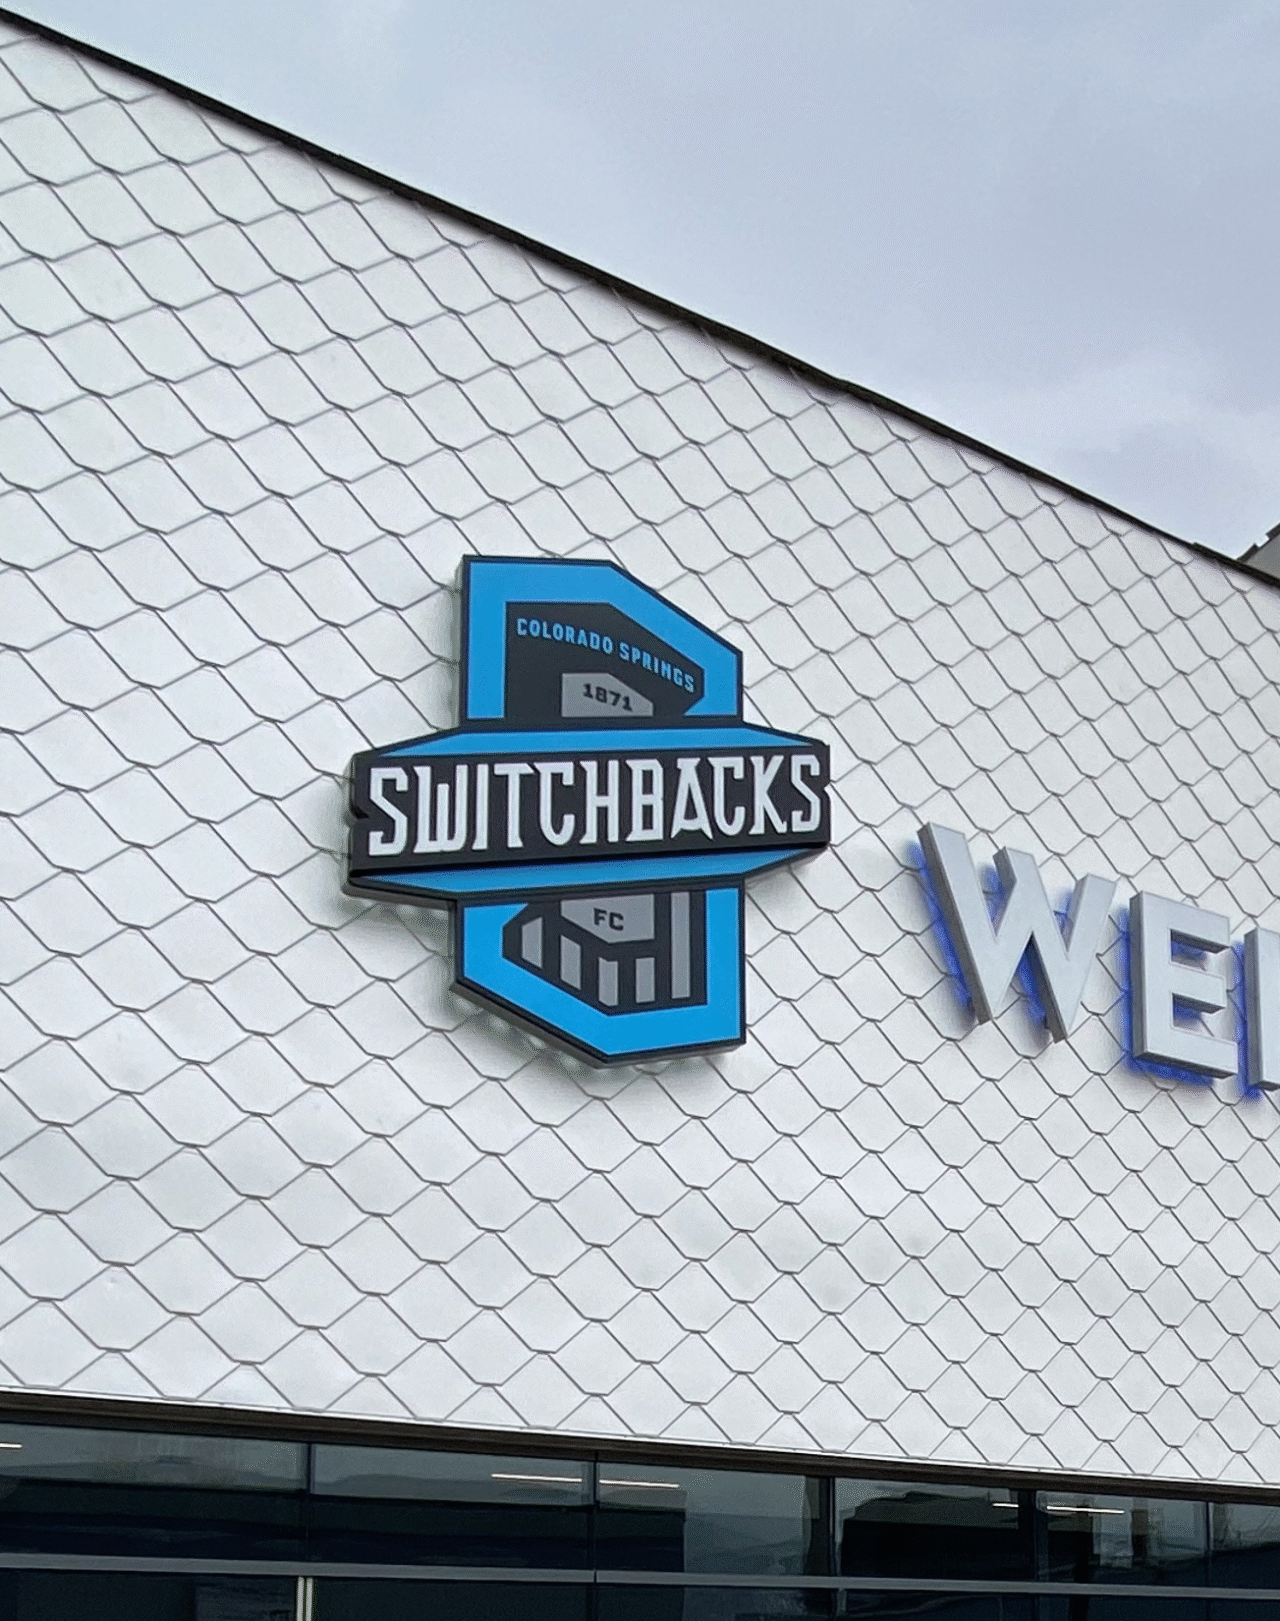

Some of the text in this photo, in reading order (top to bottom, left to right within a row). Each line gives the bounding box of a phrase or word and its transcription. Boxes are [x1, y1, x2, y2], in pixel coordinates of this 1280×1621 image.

[516, 617, 695, 693] COLORADO SPRINGS
[583, 683, 633, 711] 1871
[368, 754, 822, 856] SWITCHBACKS
[593, 908, 625, 931] FC
